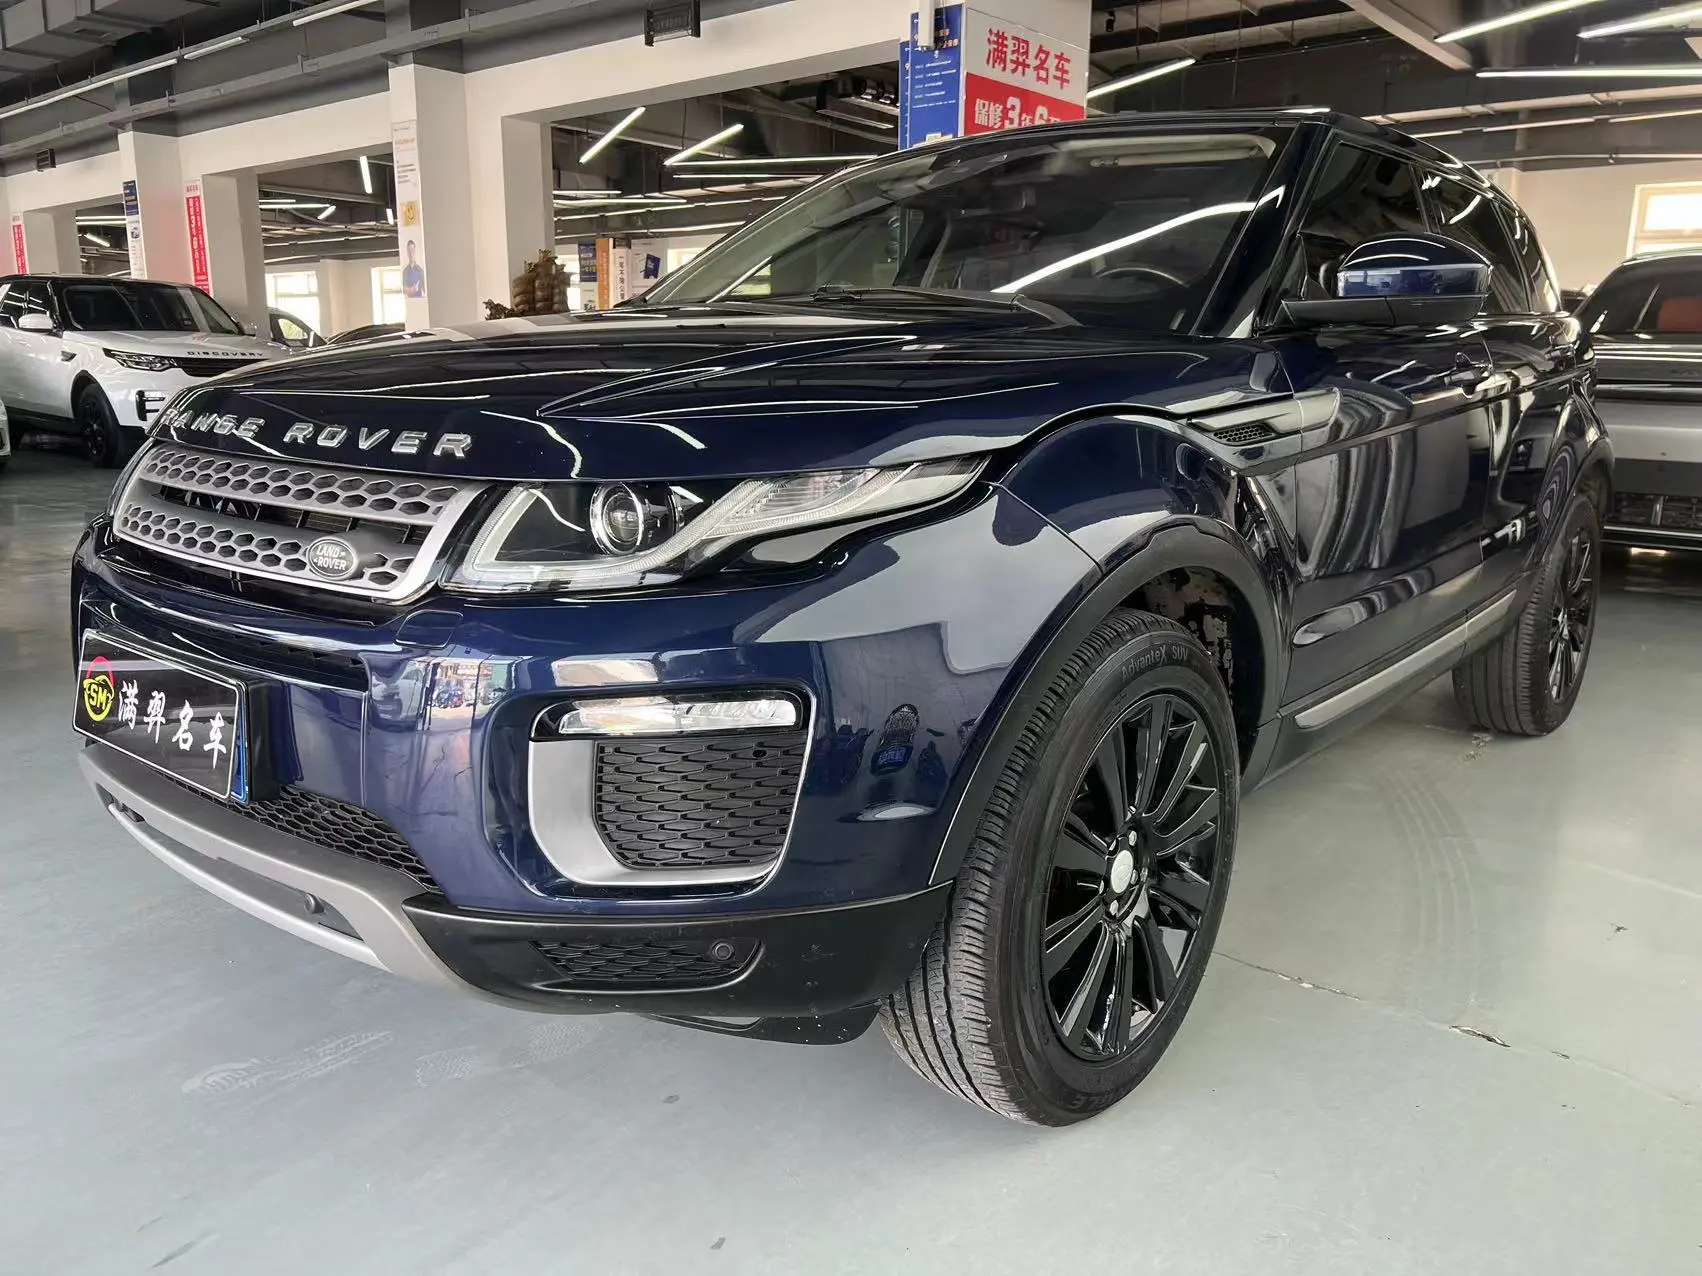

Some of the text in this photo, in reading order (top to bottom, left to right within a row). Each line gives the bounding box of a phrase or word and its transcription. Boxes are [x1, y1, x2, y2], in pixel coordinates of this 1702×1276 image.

[986, 28, 1071, 89] 满羿名车
[973, 96, 1061, 128] 保修3年6
[160, 407, 473, 457] RANGE ROVER
[316, 544, 341, 558] LAND
[317, 556, 347, 570] ROVER
[1122, 644, 1188, 683] AdvanteX SUV
[89, 683, 108, 711] SM
[117, 679, 227, 770] 满羿名车
